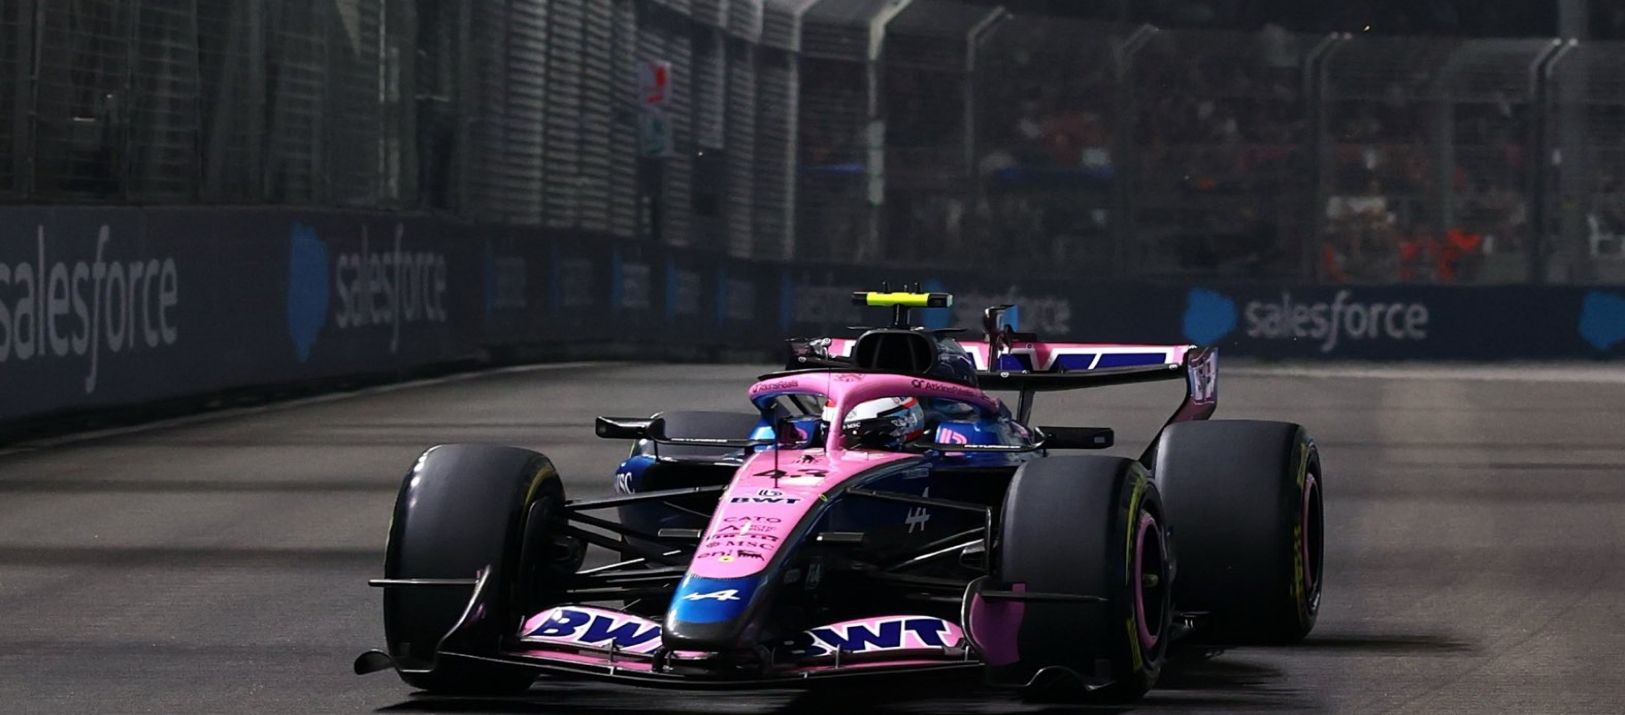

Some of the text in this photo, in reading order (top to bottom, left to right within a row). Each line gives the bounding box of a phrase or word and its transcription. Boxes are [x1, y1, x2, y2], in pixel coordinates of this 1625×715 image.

[336, 224, 447, 353] salesforce
[1245, 290, 1430, 352] salesforce
[730, 496, 801, 504] BWT
[723, 515, 782, 524] CATO
[726, 540, 775, 551] MSC
[527, 609, 662, 648] BW
